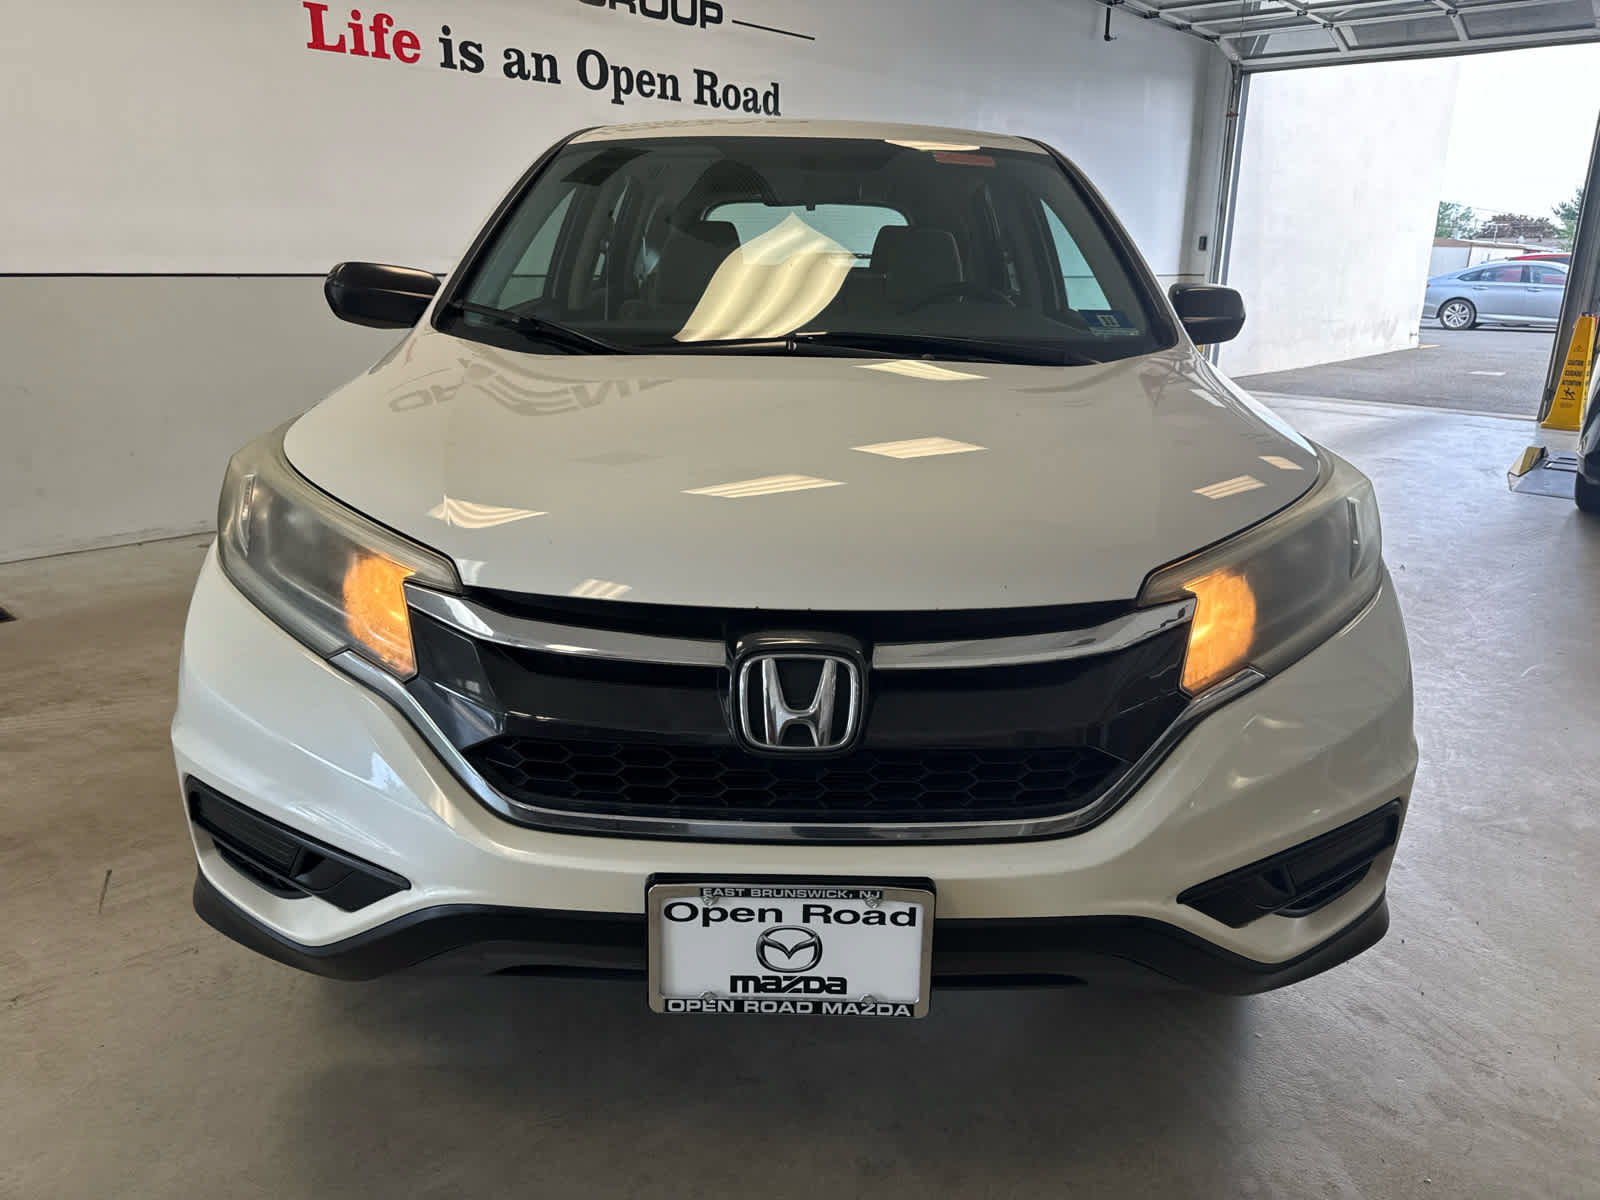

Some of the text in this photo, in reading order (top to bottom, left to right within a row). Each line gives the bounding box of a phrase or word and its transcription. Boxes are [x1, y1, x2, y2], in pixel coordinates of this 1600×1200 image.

[302, 0, 781, 116] Life is an Open Road
[702, 888, 881, 899] EAST BRUNSWICK, NJ
[664, 902, 916, 927] Open Road
[667, 1000, 911, 1017] OPEN ROAD MAZDA
